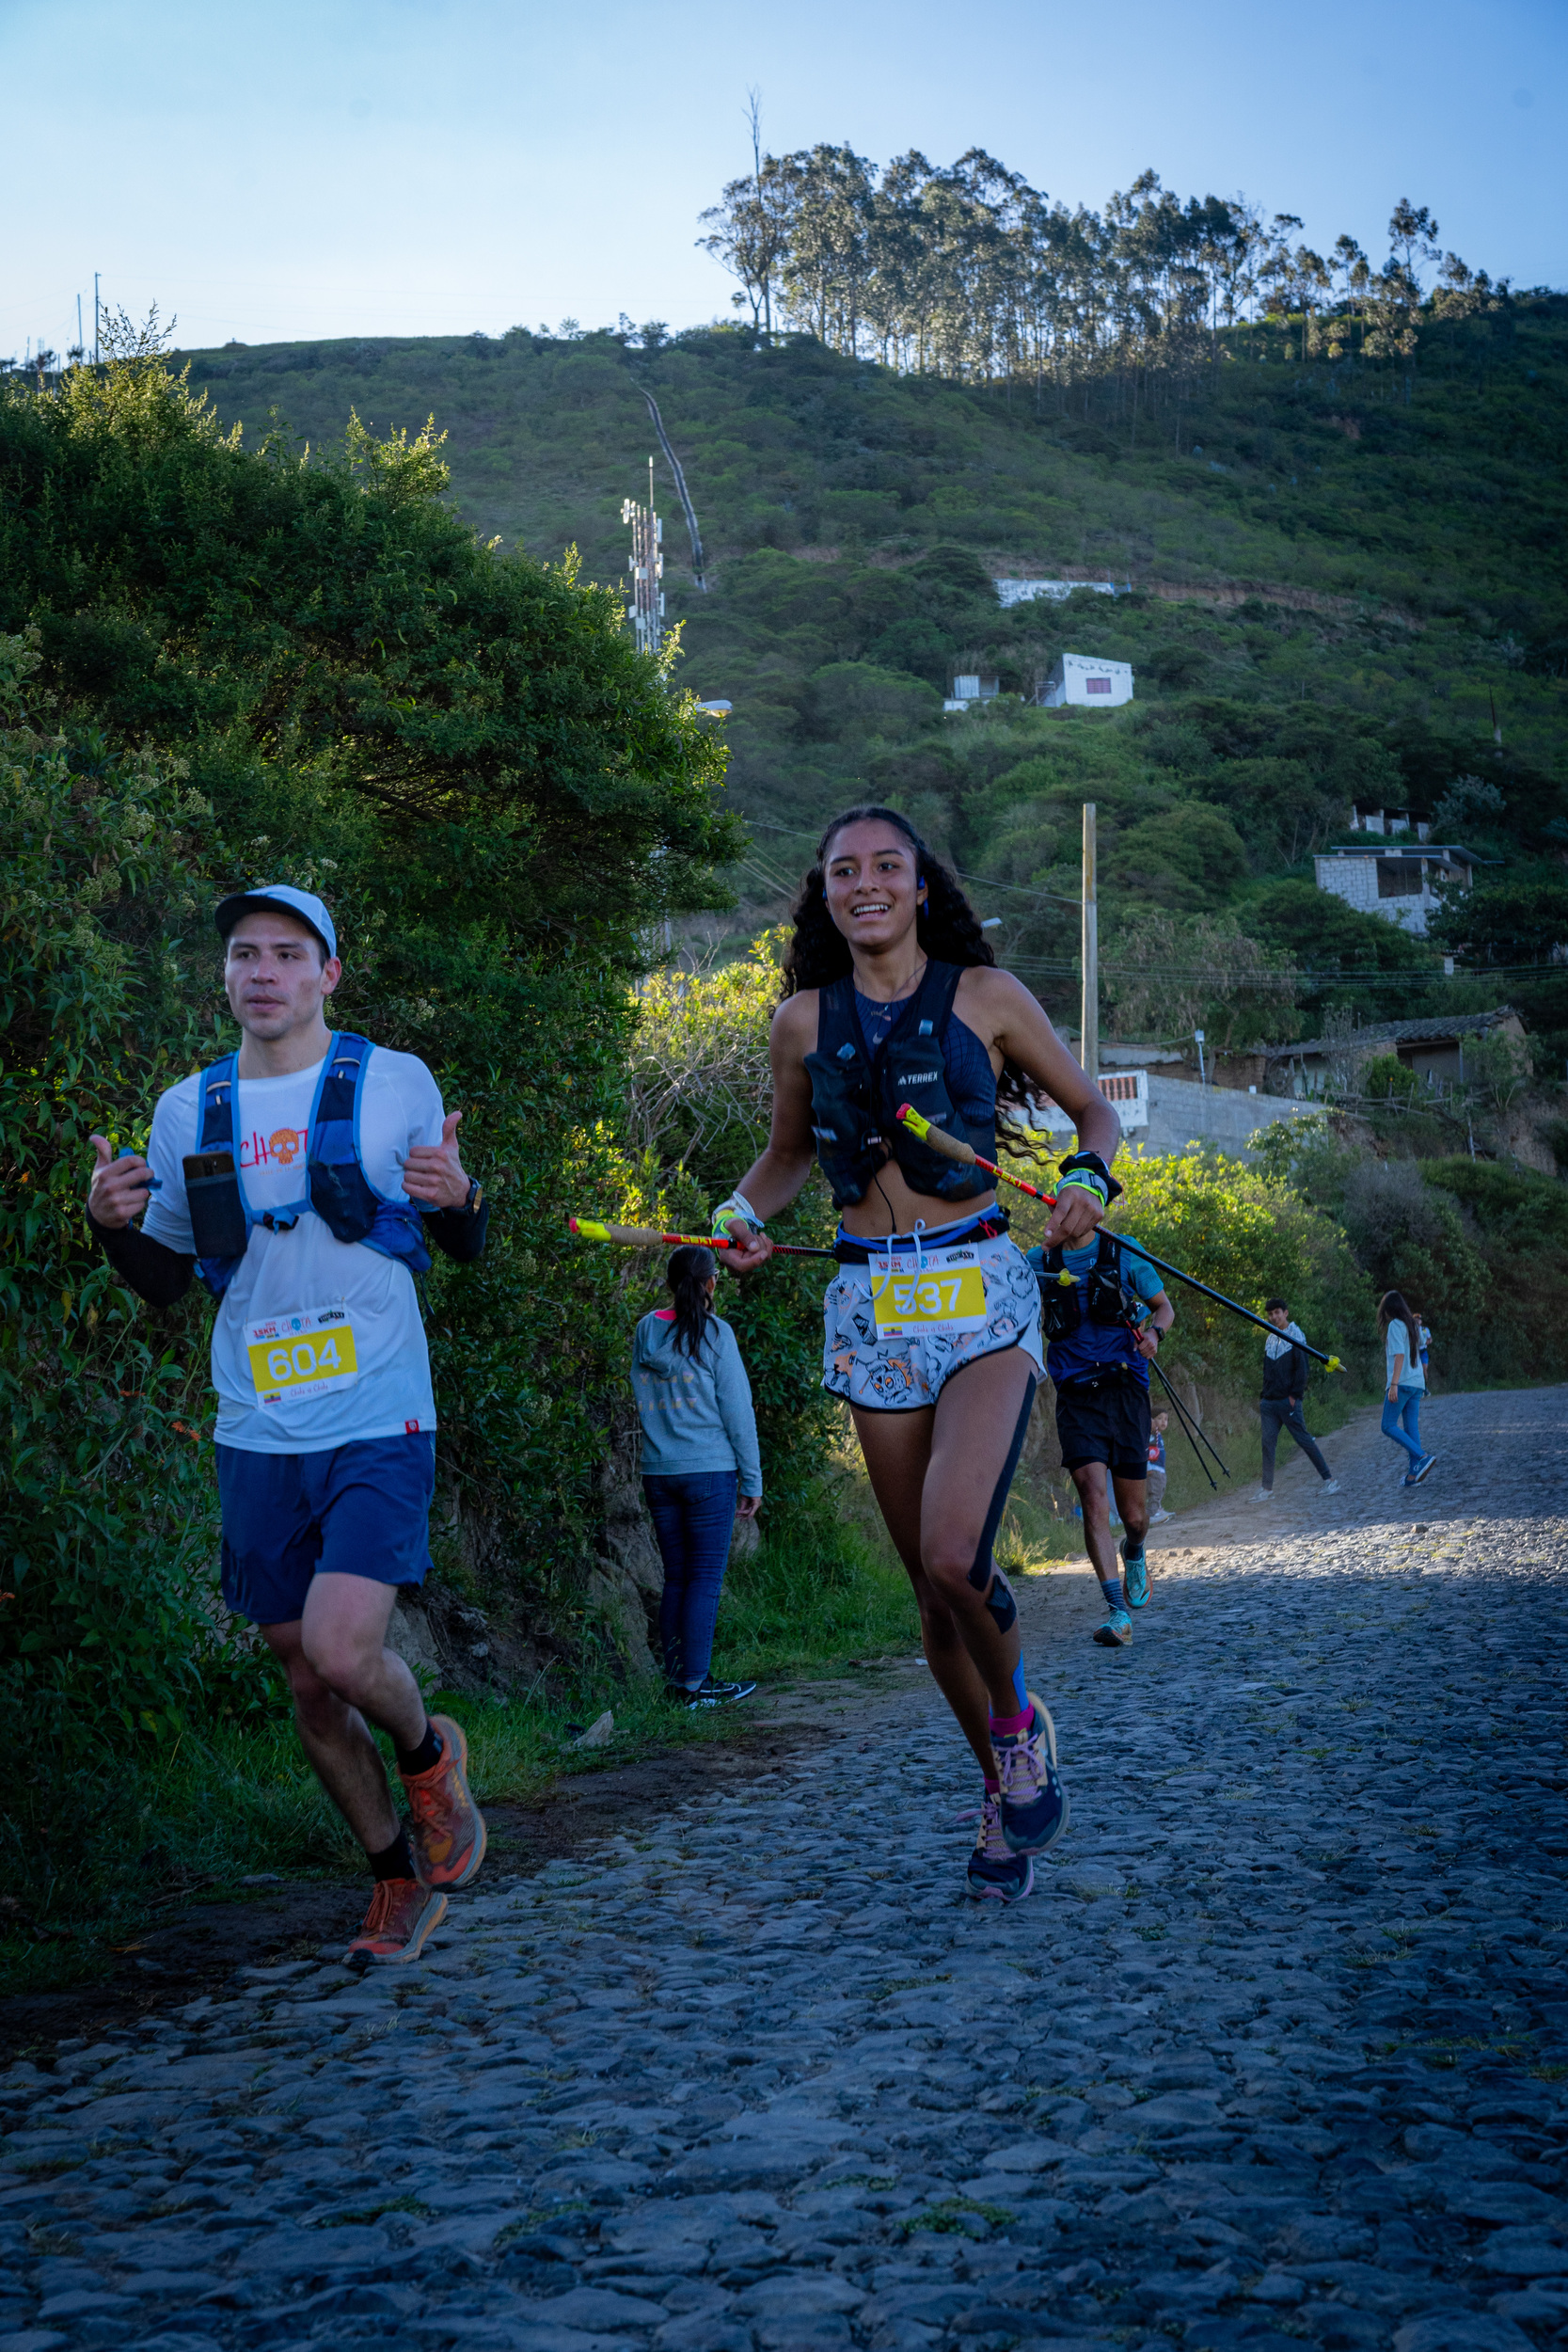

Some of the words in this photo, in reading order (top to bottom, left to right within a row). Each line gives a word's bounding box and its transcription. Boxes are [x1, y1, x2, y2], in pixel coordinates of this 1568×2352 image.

[908, 1071, 938, 1085] TERREX
[991, 1166, 1022, 1188] LEKI
[894, 1278, 962, 1315] 537
[267, 1338, 341, 1381] 604
